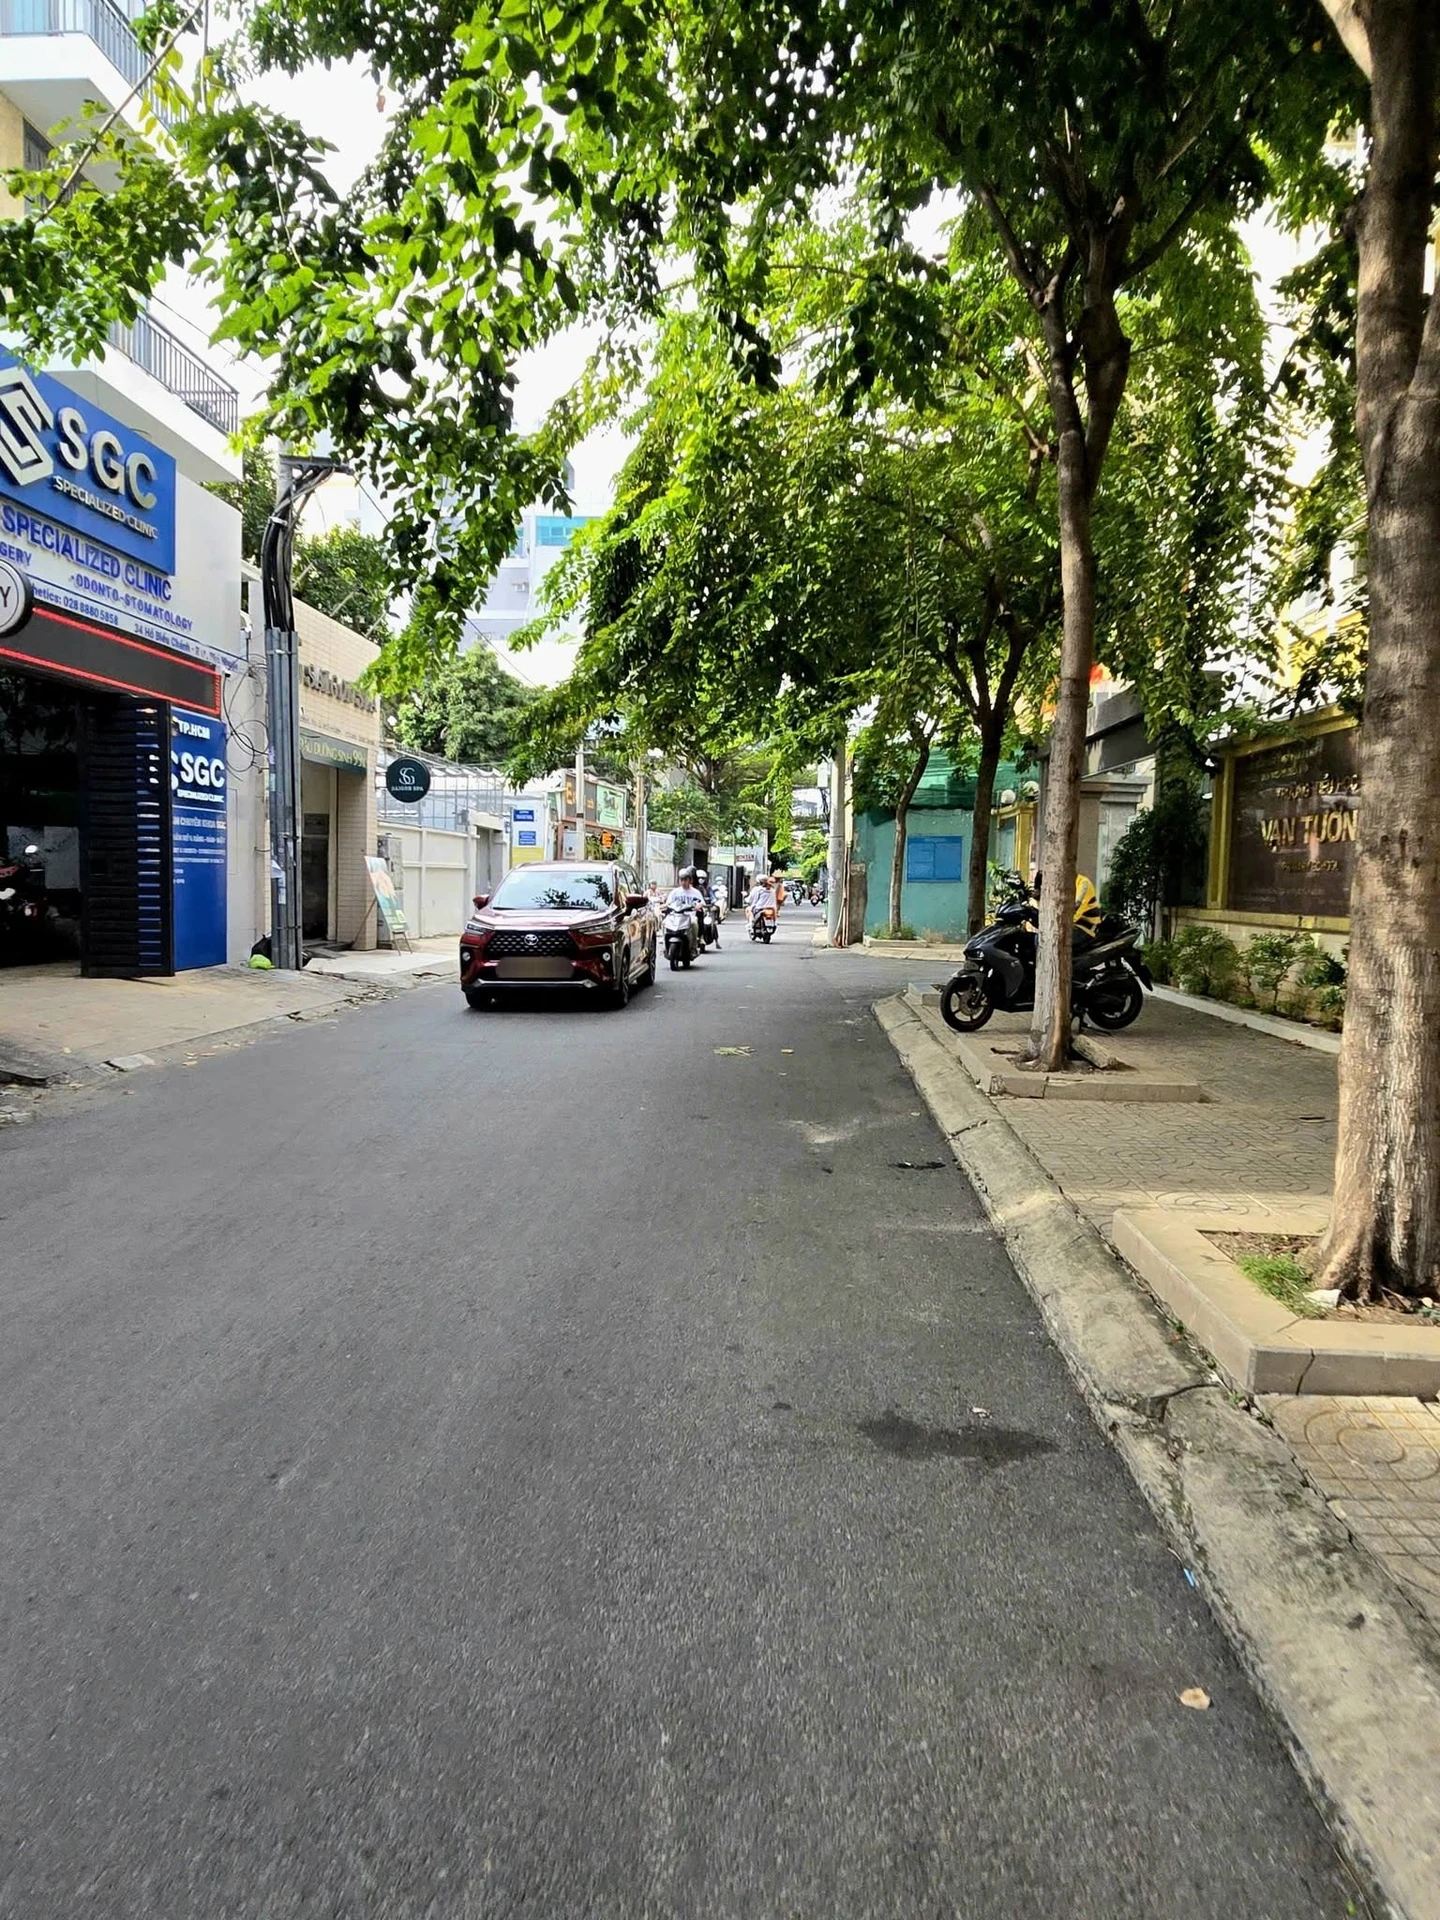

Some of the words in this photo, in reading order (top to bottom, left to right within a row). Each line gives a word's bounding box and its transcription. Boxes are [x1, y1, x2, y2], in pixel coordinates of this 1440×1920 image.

[58, 406, 157, 509] SGC
[53, 475, 126, 521] SPECIALIZED
[126, 515, 159, 539] CLINIC
[1, 504, 121, 579] SPECIALIZED
[124, 562, 172, 601] CLINIC
[178, 719, 211, 740] TP.HCM
[180, 751, 226, 789] SGC
